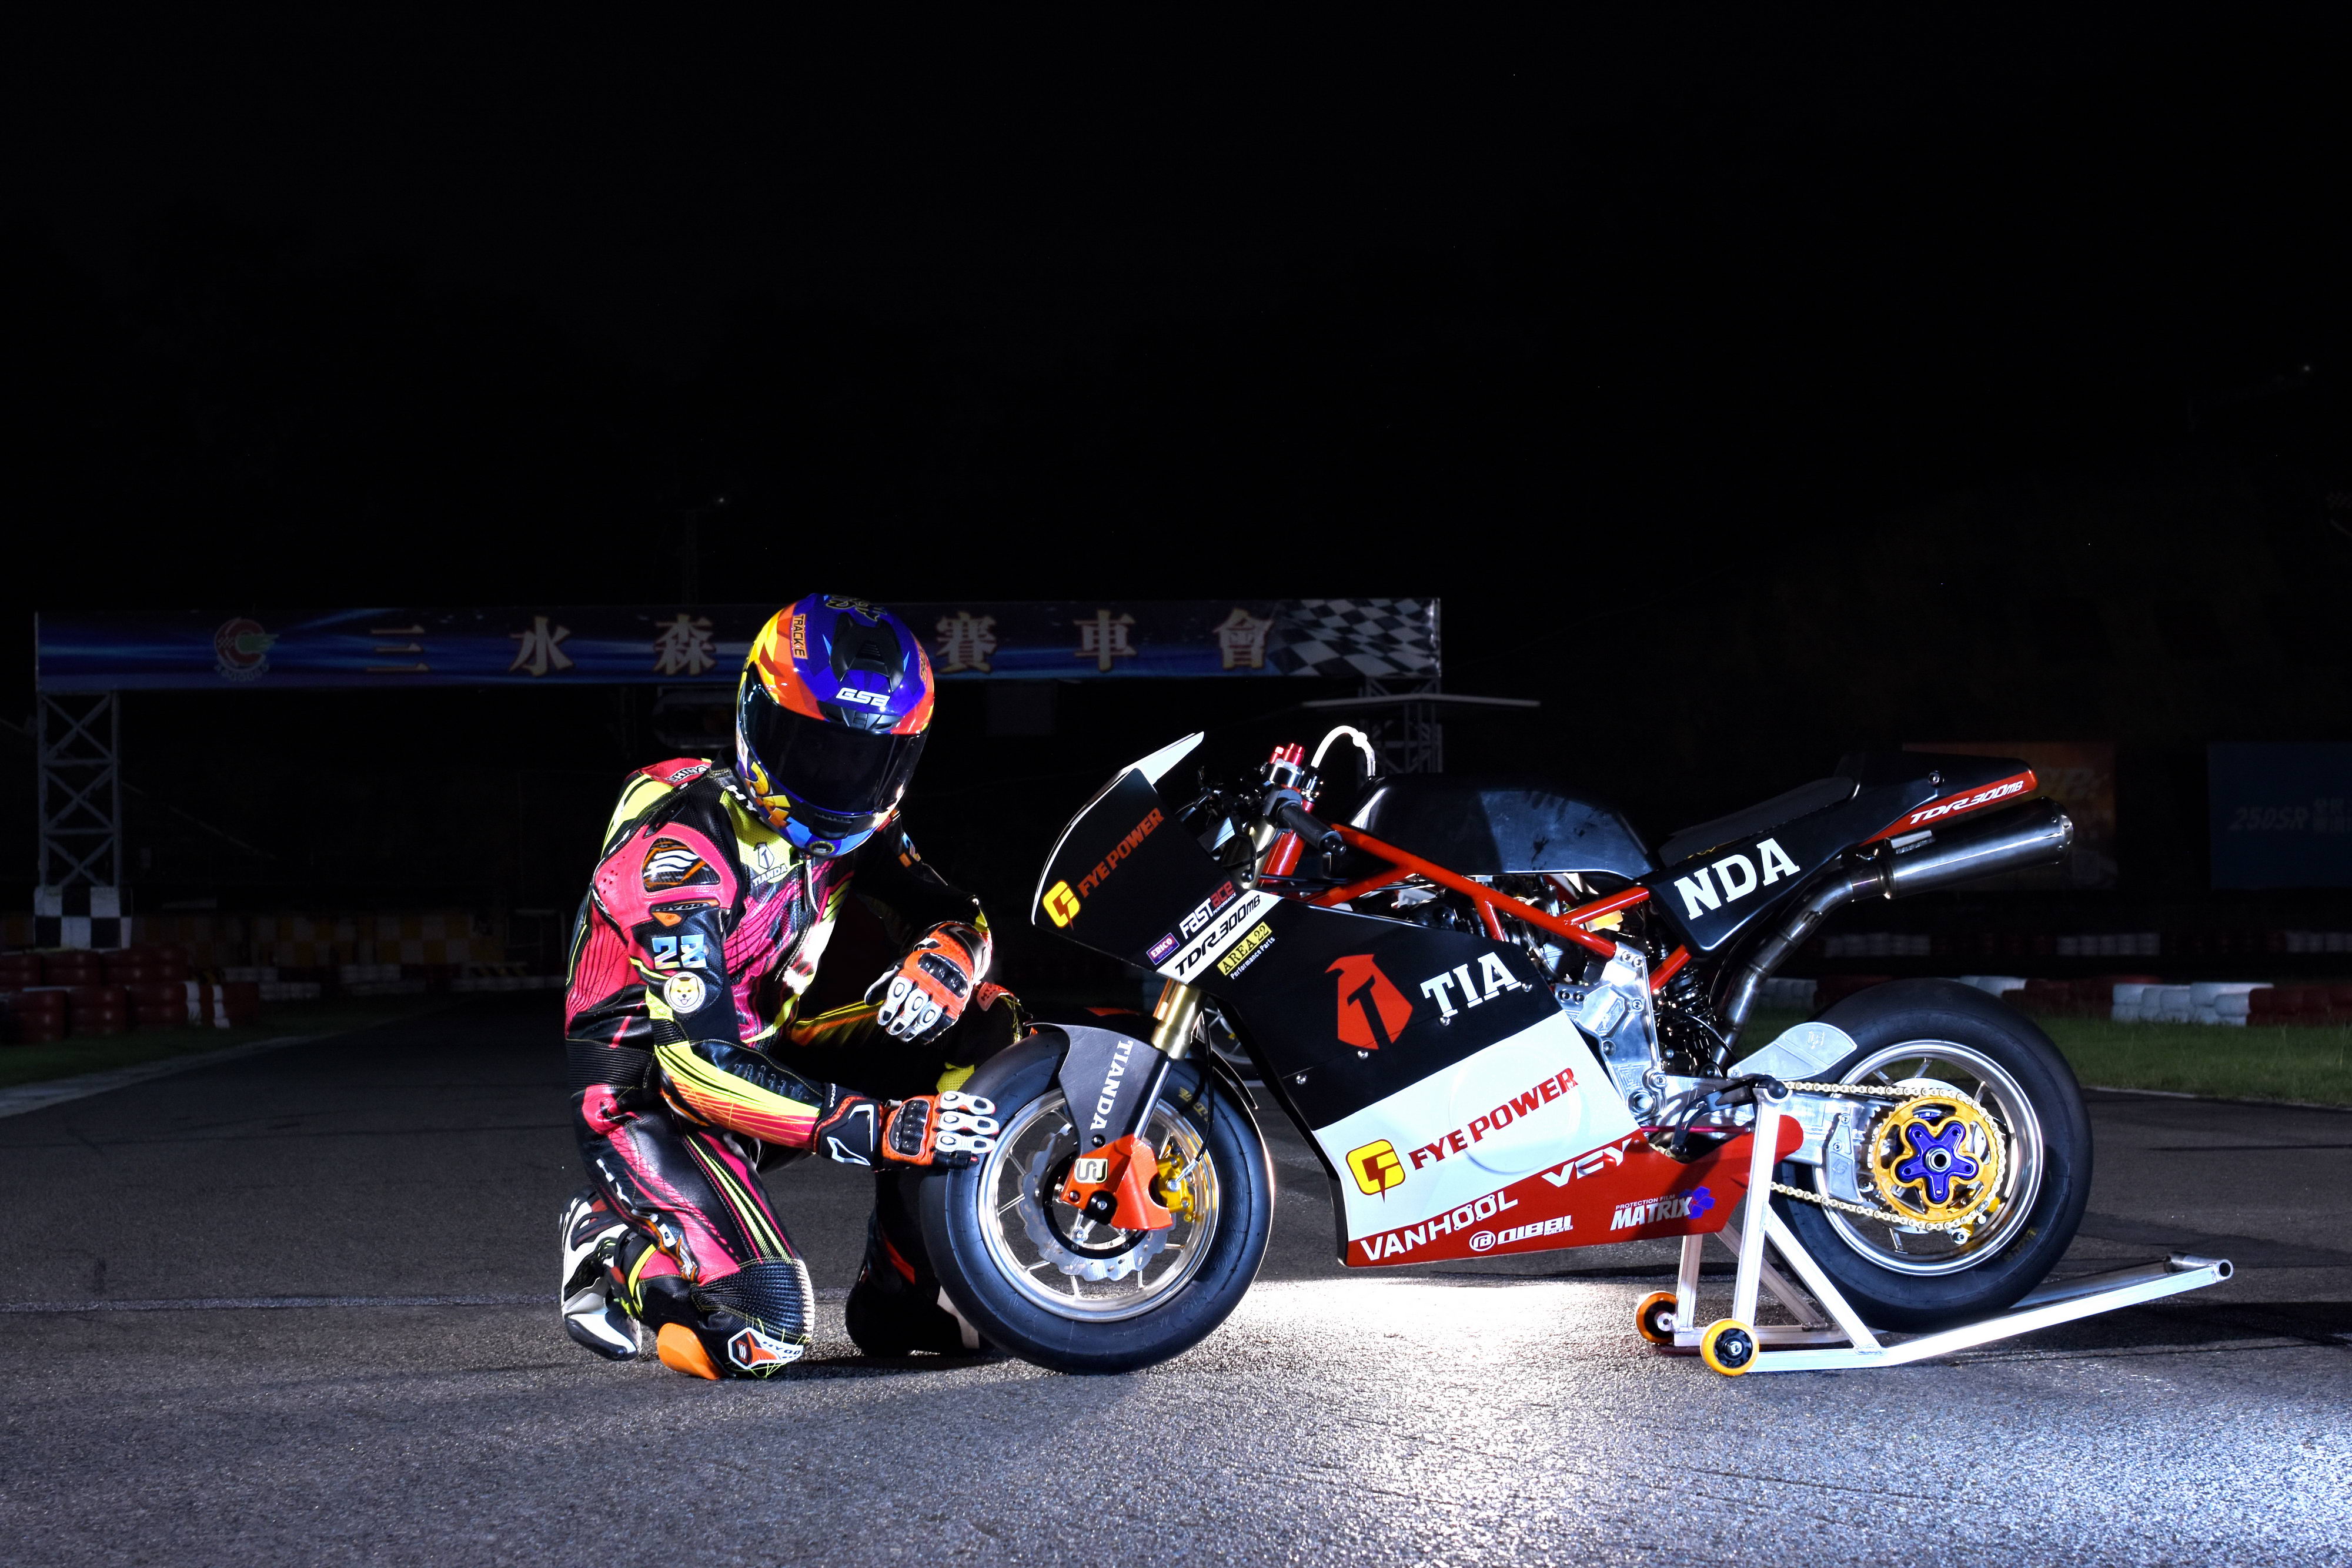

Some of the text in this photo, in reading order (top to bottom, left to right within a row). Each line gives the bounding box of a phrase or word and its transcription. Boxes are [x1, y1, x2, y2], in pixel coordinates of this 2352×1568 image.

[366, 608, 1275, 676] 三水森賽車會
[752, 864, 788, 887] TIANDA
[1077, 807, 1164, 898] FYE POWER
[1673, 838, 1800, 920] NDA
[1212, 891, 1237, 915] PERFORMANCE
[1150, 937, 1174, 958] ERICO
[1221, 924, 1270, 974] AREA 22
[1230, 936, 1275, 980] Performance Parts
[1419, 951, 1522, 1017] TIA
[1090, 1039, 1134, 1131] TIANDA
[1408, 1129, 1468, 1171] FYE
[1468, 1067, 1579, 1143] POWER
[1360, 1191, 1518, 1261] VANHOOL
[1610, 1196, 1693, 1231] MATRIX
[1615, 1197, 1658, 1211] PROTECTION
